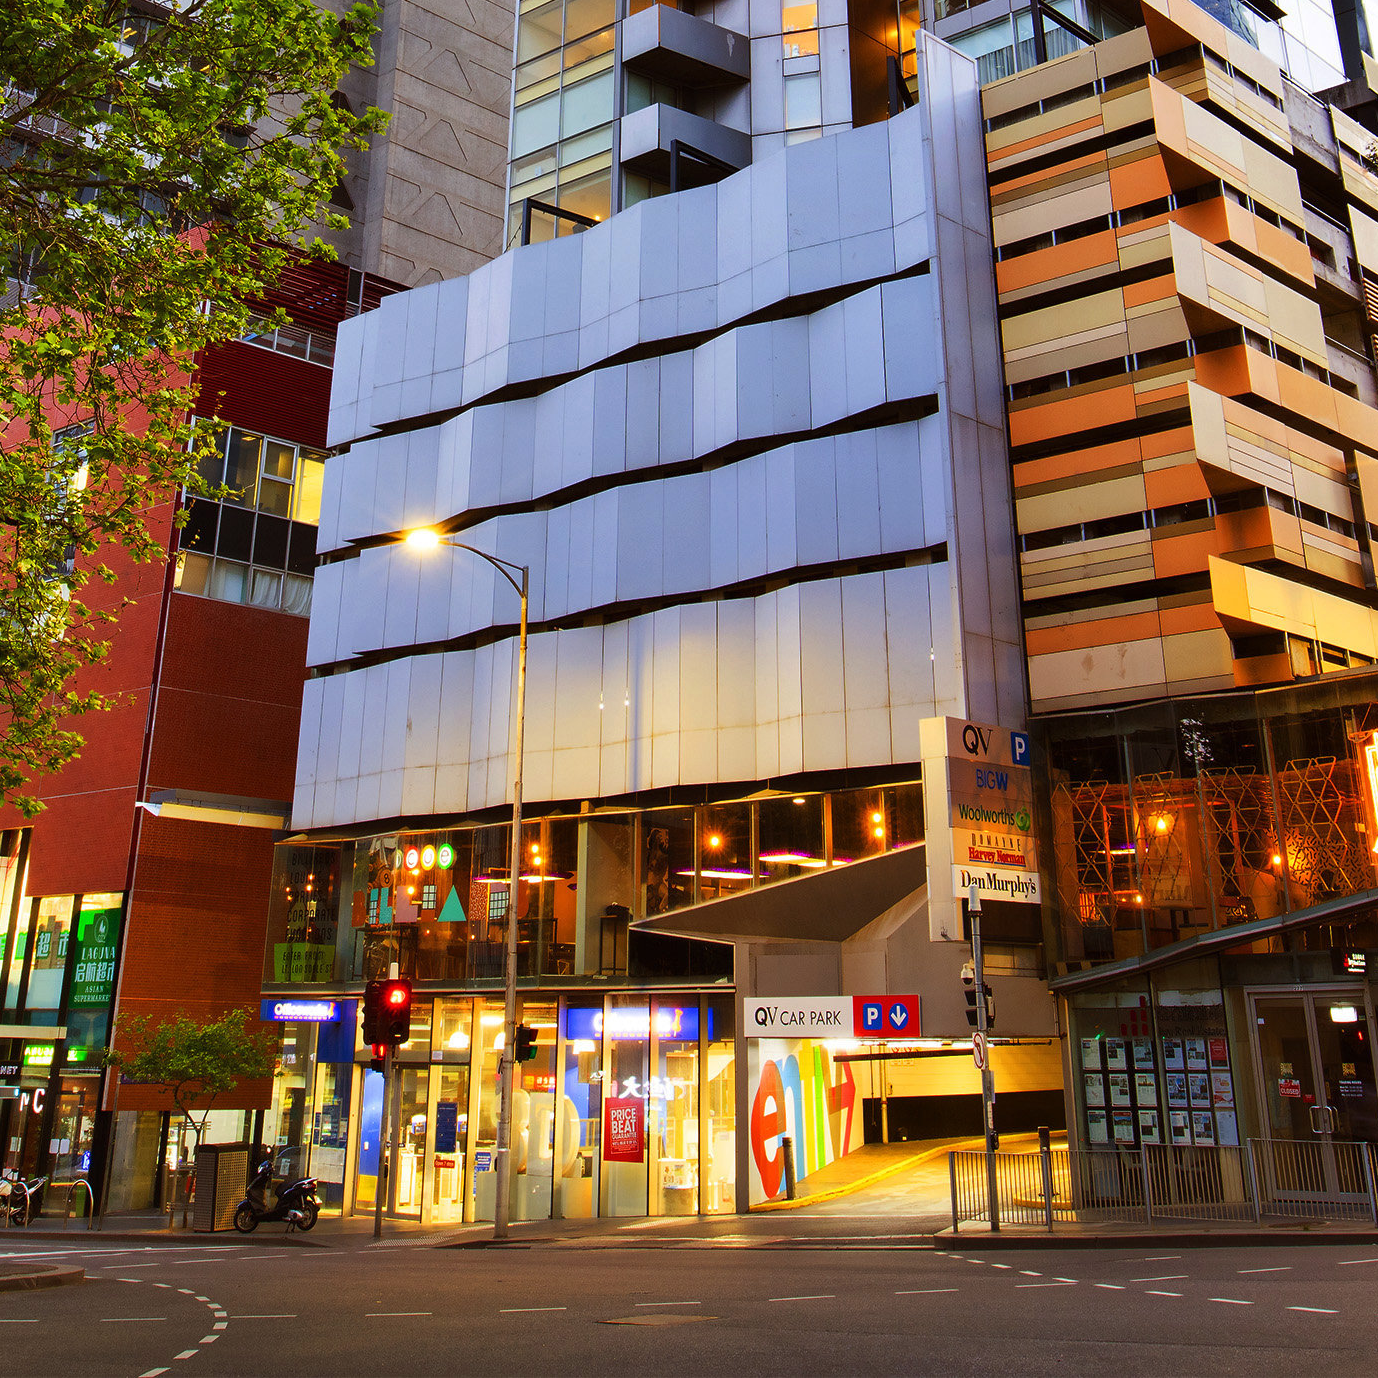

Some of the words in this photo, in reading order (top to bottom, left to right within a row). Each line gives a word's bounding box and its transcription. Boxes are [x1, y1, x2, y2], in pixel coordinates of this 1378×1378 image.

[962, 724, 993, 756] QV
[1015, 736, 1026, 761] P
[958, 803, 1015, 827] Woolworths
[971, 832, 1021, 852] DOMAYNE
[968, 846, 995, 864] Harvey
[996, 849, 1026, 866] Norman
[960, 868, 986, 889] Dan
[986, 871, 1037, 899] Murphy's
[82, 946, 115, 960] LAGUNA
[292, 964, 324, 974] LONSDLE
[85, 985, 104, 993] ASIAN
[74, 994, 112, 1002] SUPERMARKE
[754, 1006, 778, 1027] QV
[780, 1010, 805, 1026] CAR
[810, 1010, 842, 1026] PARK
[867, 1007, 878, 1026] P
[1280, 1087, 1299, 1095] CLOSED
[612, 1108, 636, 1121] PRICE
[612, 1120, 636, 1134] BEAT
[435, 1159, 443, 1168] Open
